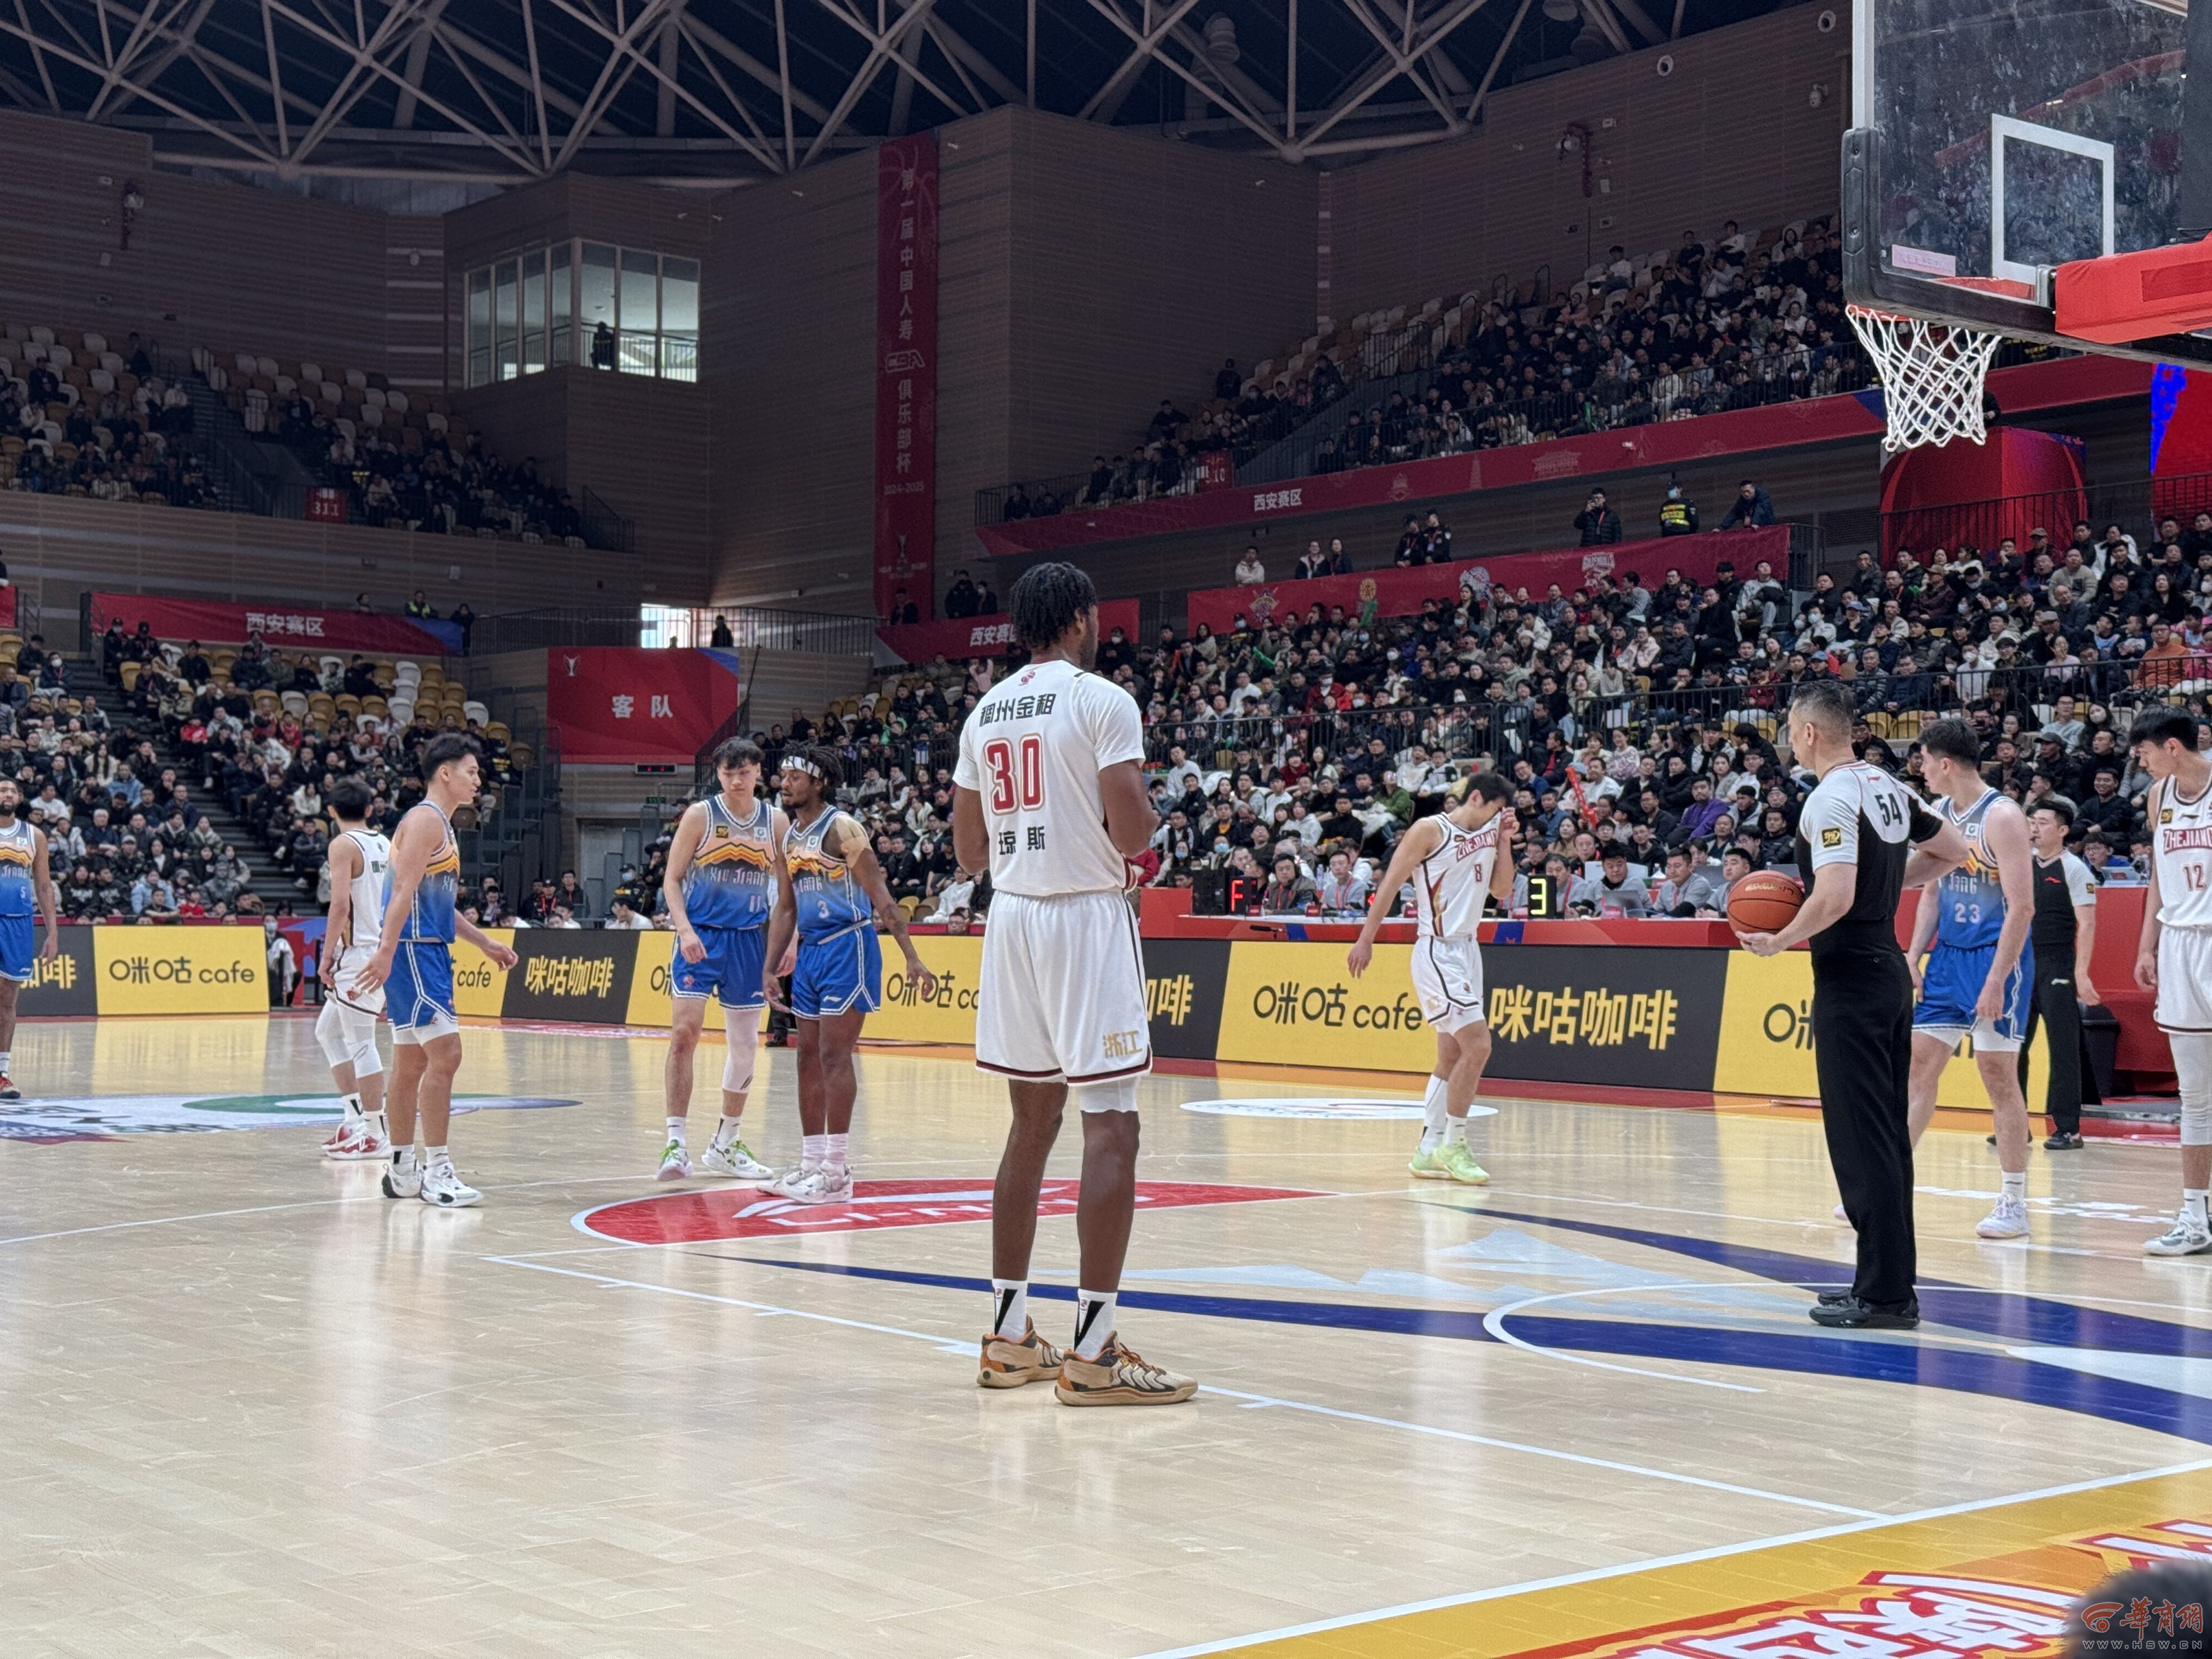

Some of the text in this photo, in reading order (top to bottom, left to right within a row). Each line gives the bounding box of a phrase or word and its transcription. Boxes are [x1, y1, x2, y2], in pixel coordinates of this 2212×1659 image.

[312, 501, 339, 516] 311
[1254, 488, 1302, 512] 西安赛区
[246, 612, 325, 637] 西安赛区
[979, 693, 1057, 727] 稠州金租
[984, 732, 1046, 816] 30
[1874, 793, 1903, 827] 54
[1474, 863, 1482, 882] 8
[2183, 863, 2207, 891] 12
[21, 886, 26, 899] 5
[749, 895, 761, 913] 11
[1231, 879, 1244, 912] F
[1530, 878, 1547, 915] 3
[817, 900, 829, 919] 3
[1955, 902, 1981, 924] 23
[110, 956, 255, 984] 咪咕 cafe
[456, 961, 491, 988] cafe
[525, 955, 614, 998] 咪咕咖啡
[1253, 981, 1423, 1031] 咪咕 cafe
[1488, 984, 1678, 1051] 咪咕咖啡
[1102, 1030, 1143, 1059] 浙江
